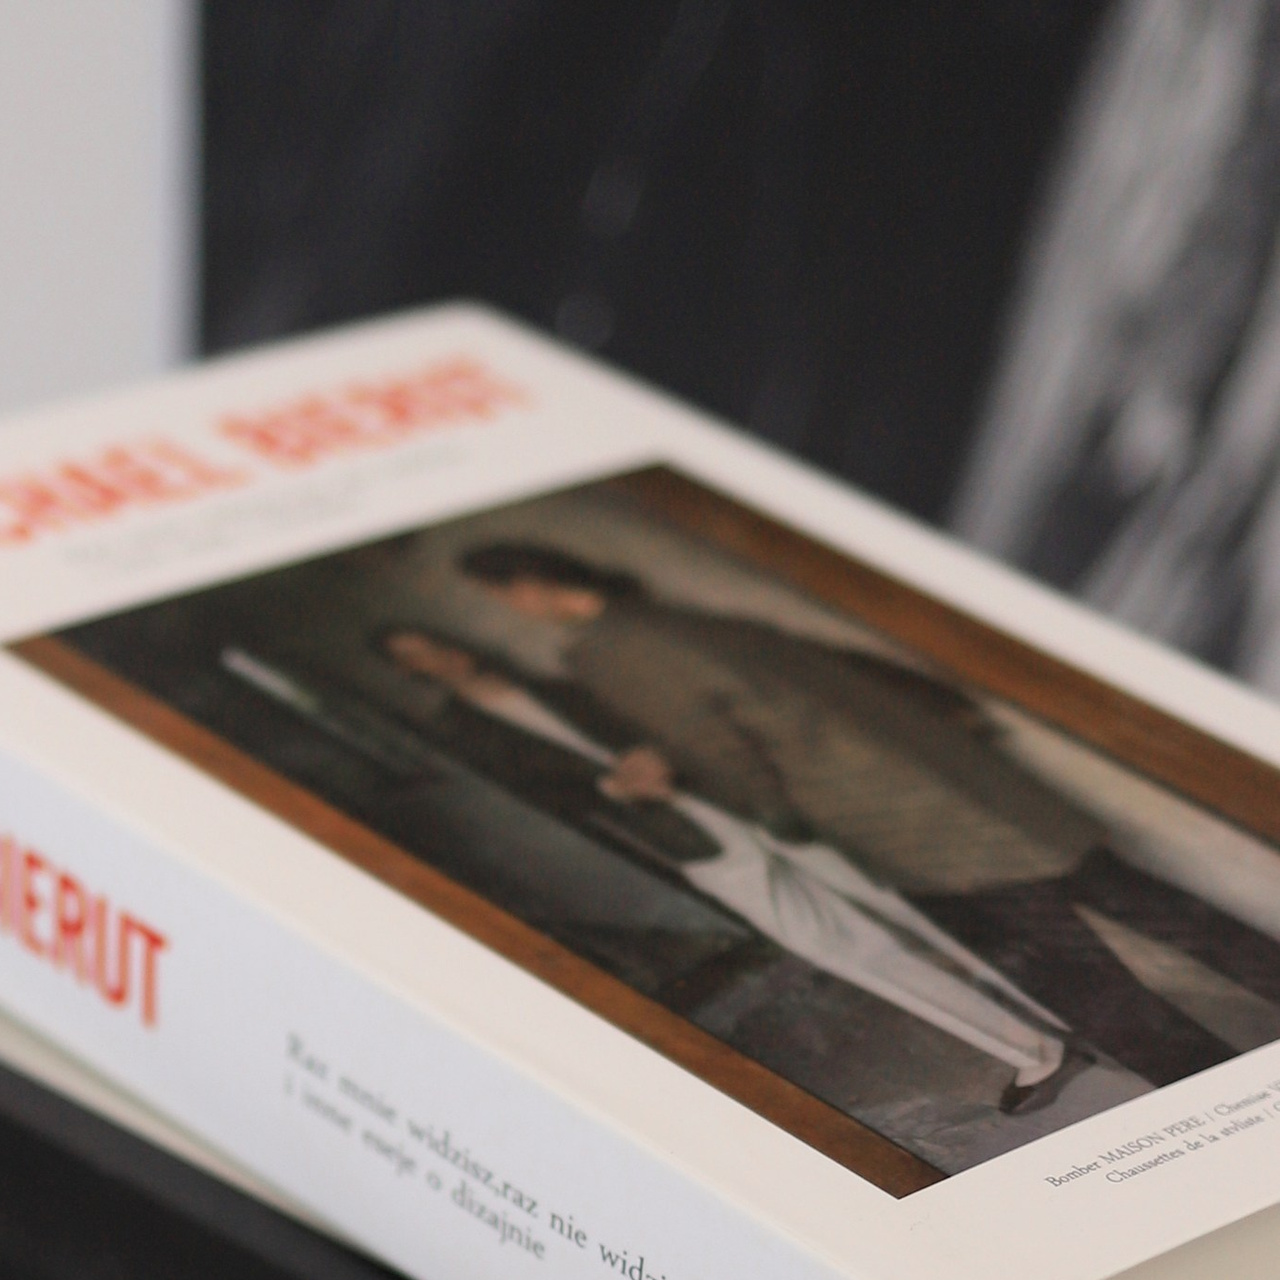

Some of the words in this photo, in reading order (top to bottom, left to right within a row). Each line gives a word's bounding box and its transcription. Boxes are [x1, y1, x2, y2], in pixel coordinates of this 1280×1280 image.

[1044, 1160, 1102, 1188] Bomber
[1098, 1131, 1167, 1165] MAISON
[1105, 1149, 1186, 1184] Chaussettes
[1183, 1139, 1205, 1152] de
[1198, 1133, 1220, 1144] la
[425, 1170, 443, 1192] o
[451, 1179, 547, 1260] dizajnie
[548, 1208, 588, 1248] nie
